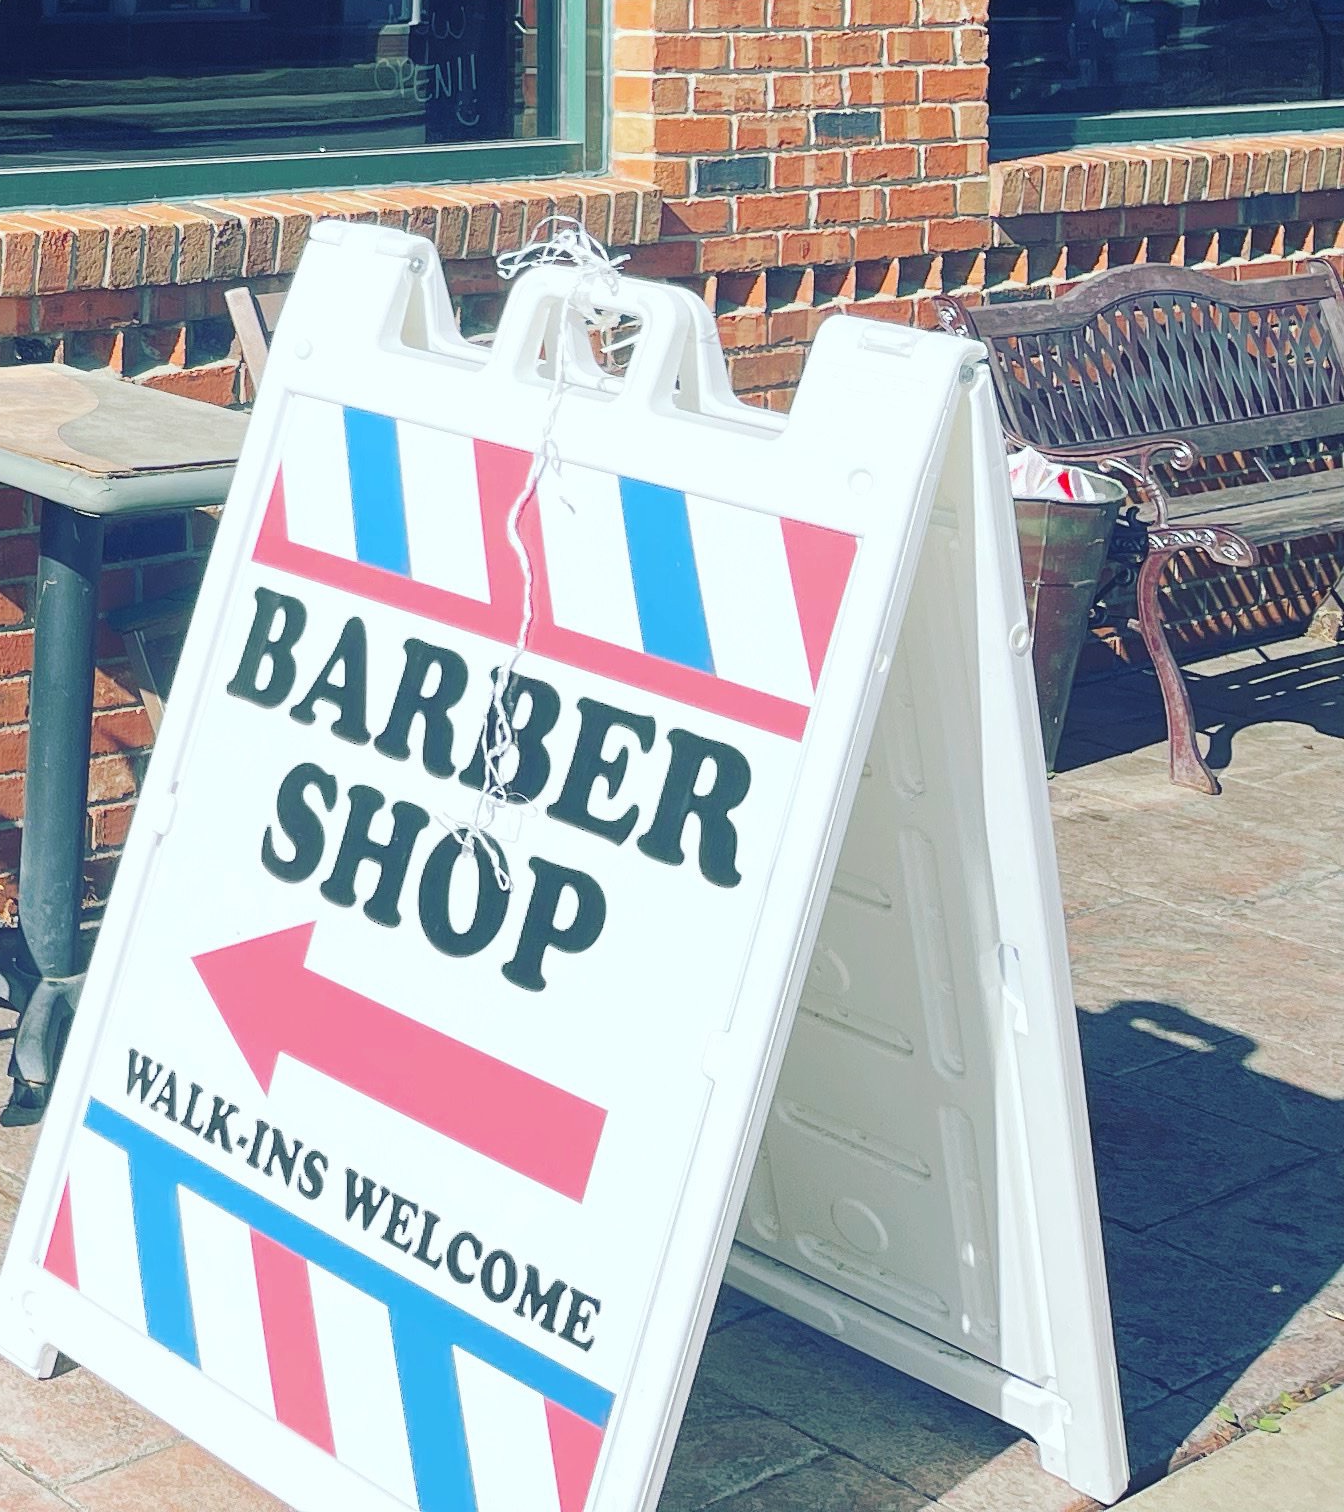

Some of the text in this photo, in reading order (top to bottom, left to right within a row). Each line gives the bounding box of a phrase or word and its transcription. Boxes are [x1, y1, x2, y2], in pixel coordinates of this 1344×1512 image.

[226, 587, 753, 889] BARBER
[259, 762, 608, 992] SHOP
[124, 1048, 602, 1353] WALK-INS WELCOME
